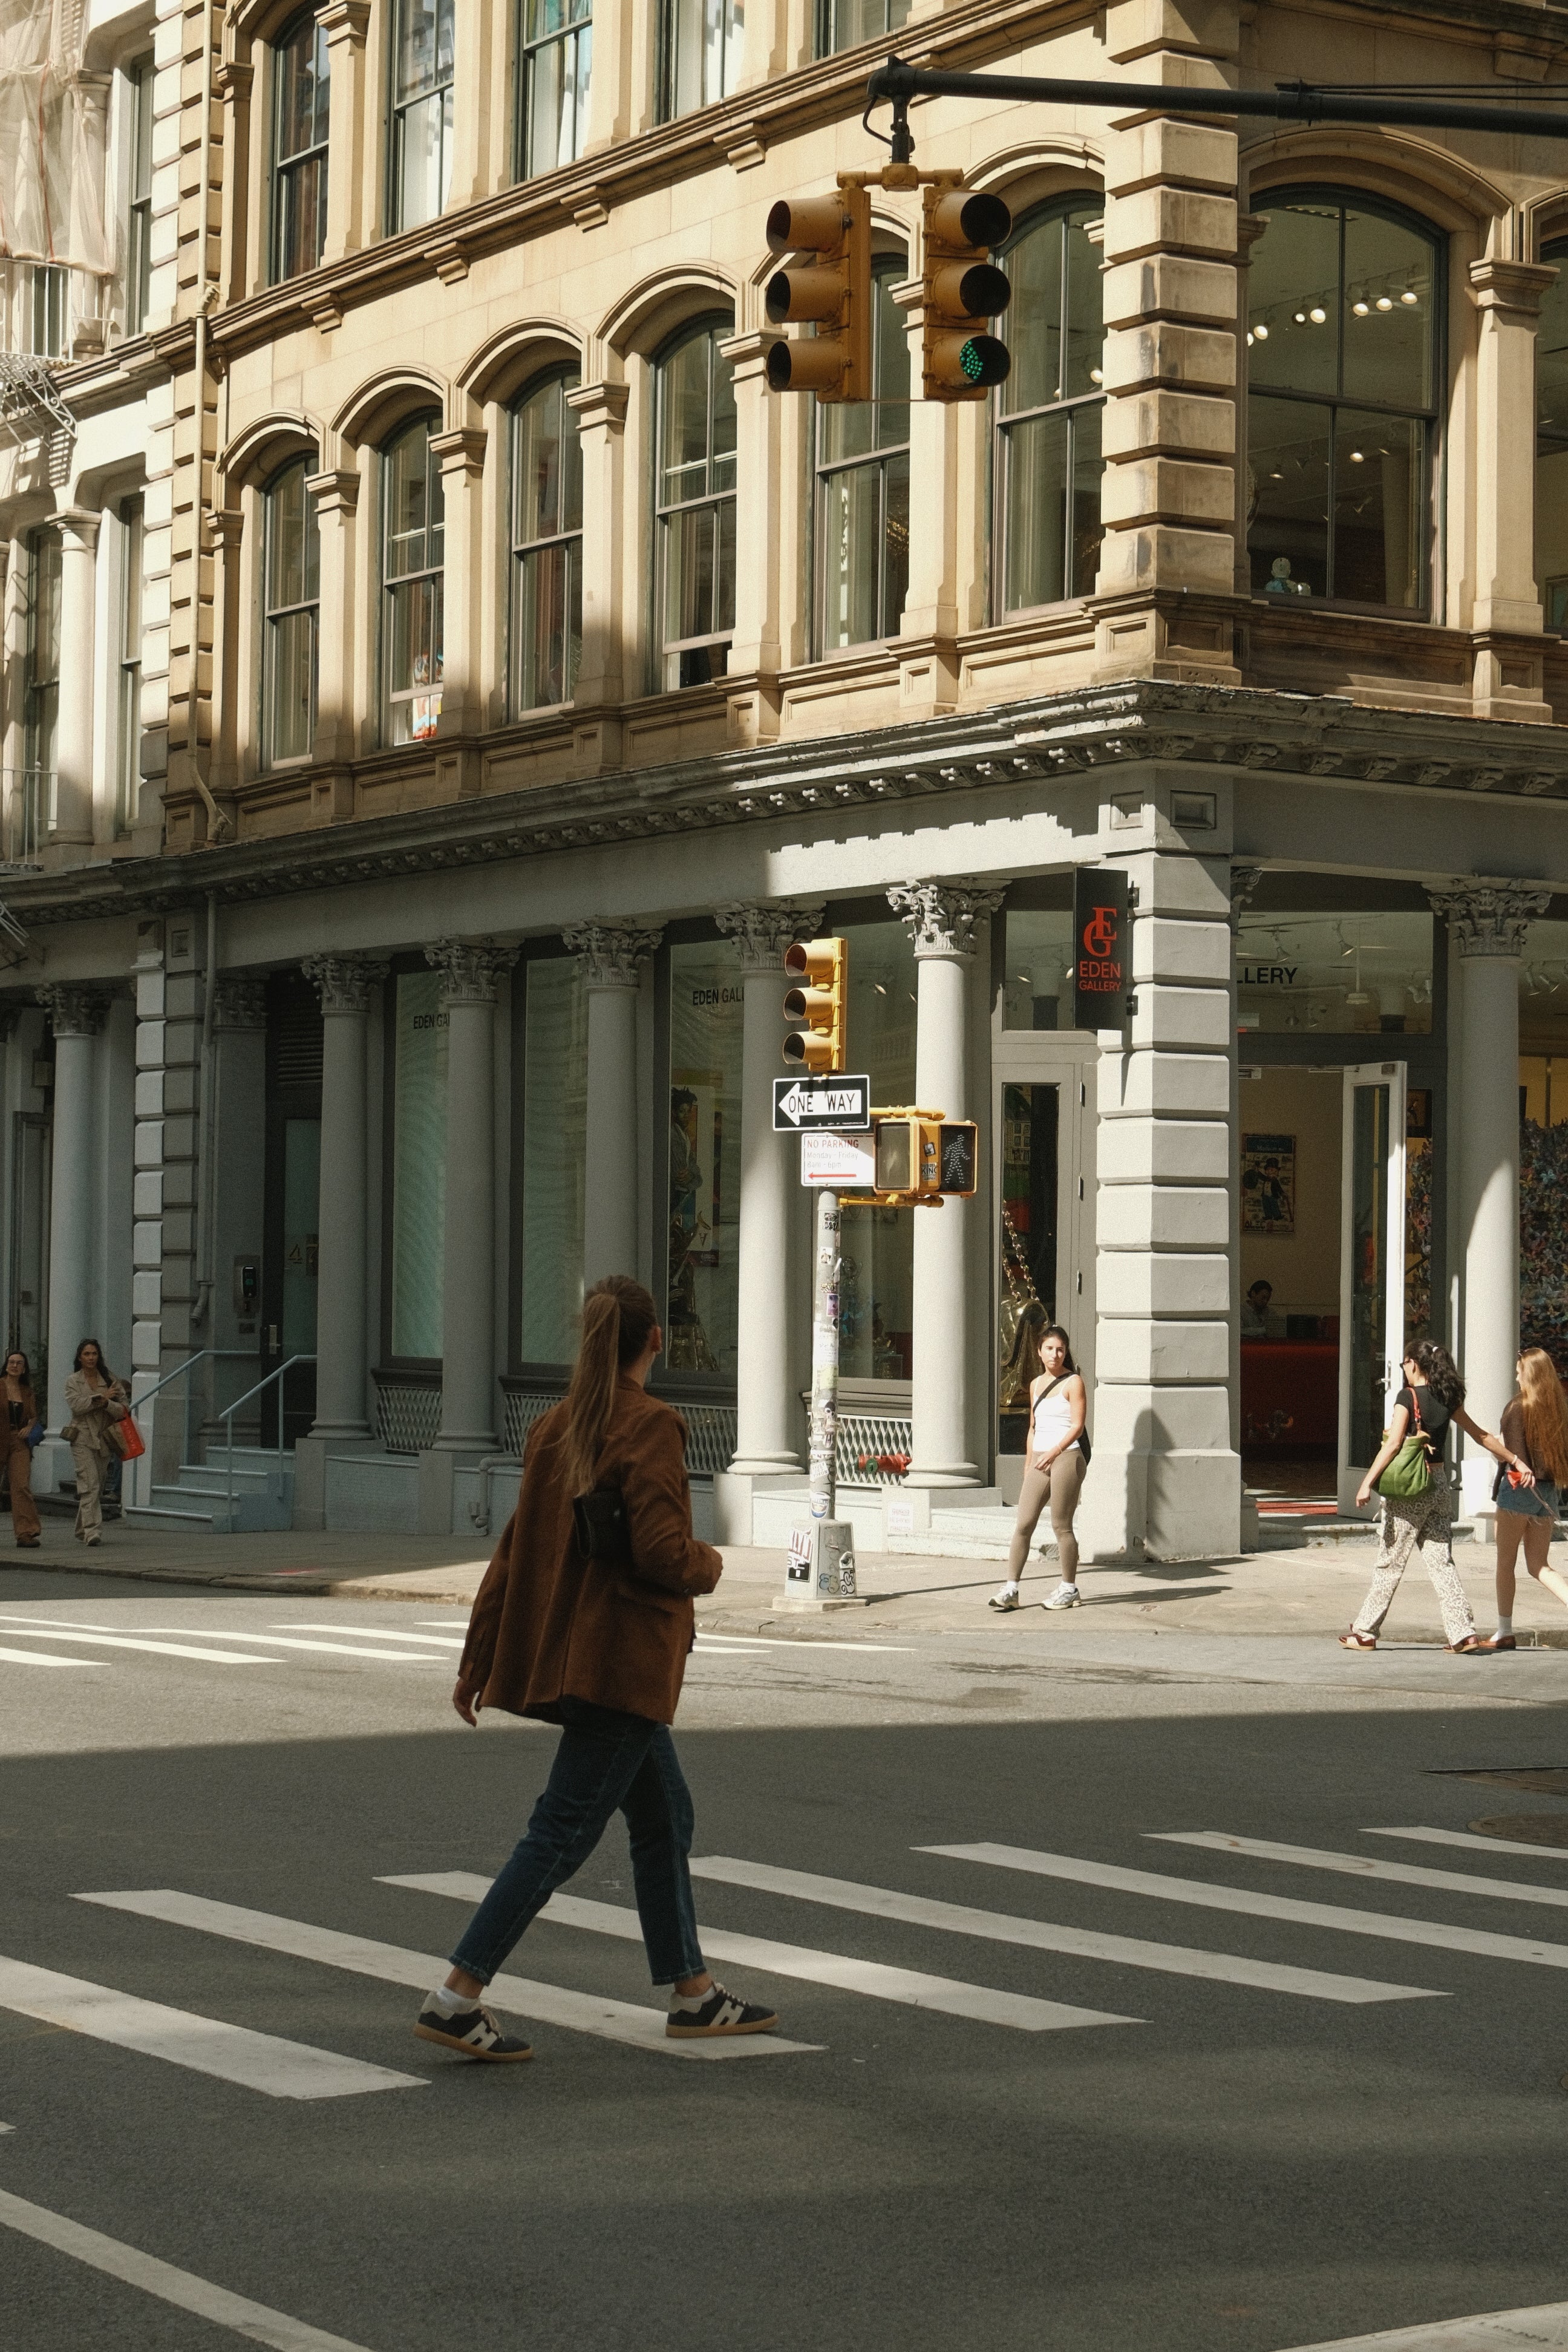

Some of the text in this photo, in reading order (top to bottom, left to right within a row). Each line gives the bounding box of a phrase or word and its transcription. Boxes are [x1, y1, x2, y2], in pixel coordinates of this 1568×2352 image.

[1079, 961, 1121, 978] EDEN
[1079, 980, 1121, 991] GALLERY
[693, 988, 719, 1005] EDEN
[413, 1014, 434, 1029] EDEN
[789, 1093, 855, 1113] ONE WAY
[807, 1139, 859, 1148] NO PARKING
[838, 1151, 858, 1160] Friday
